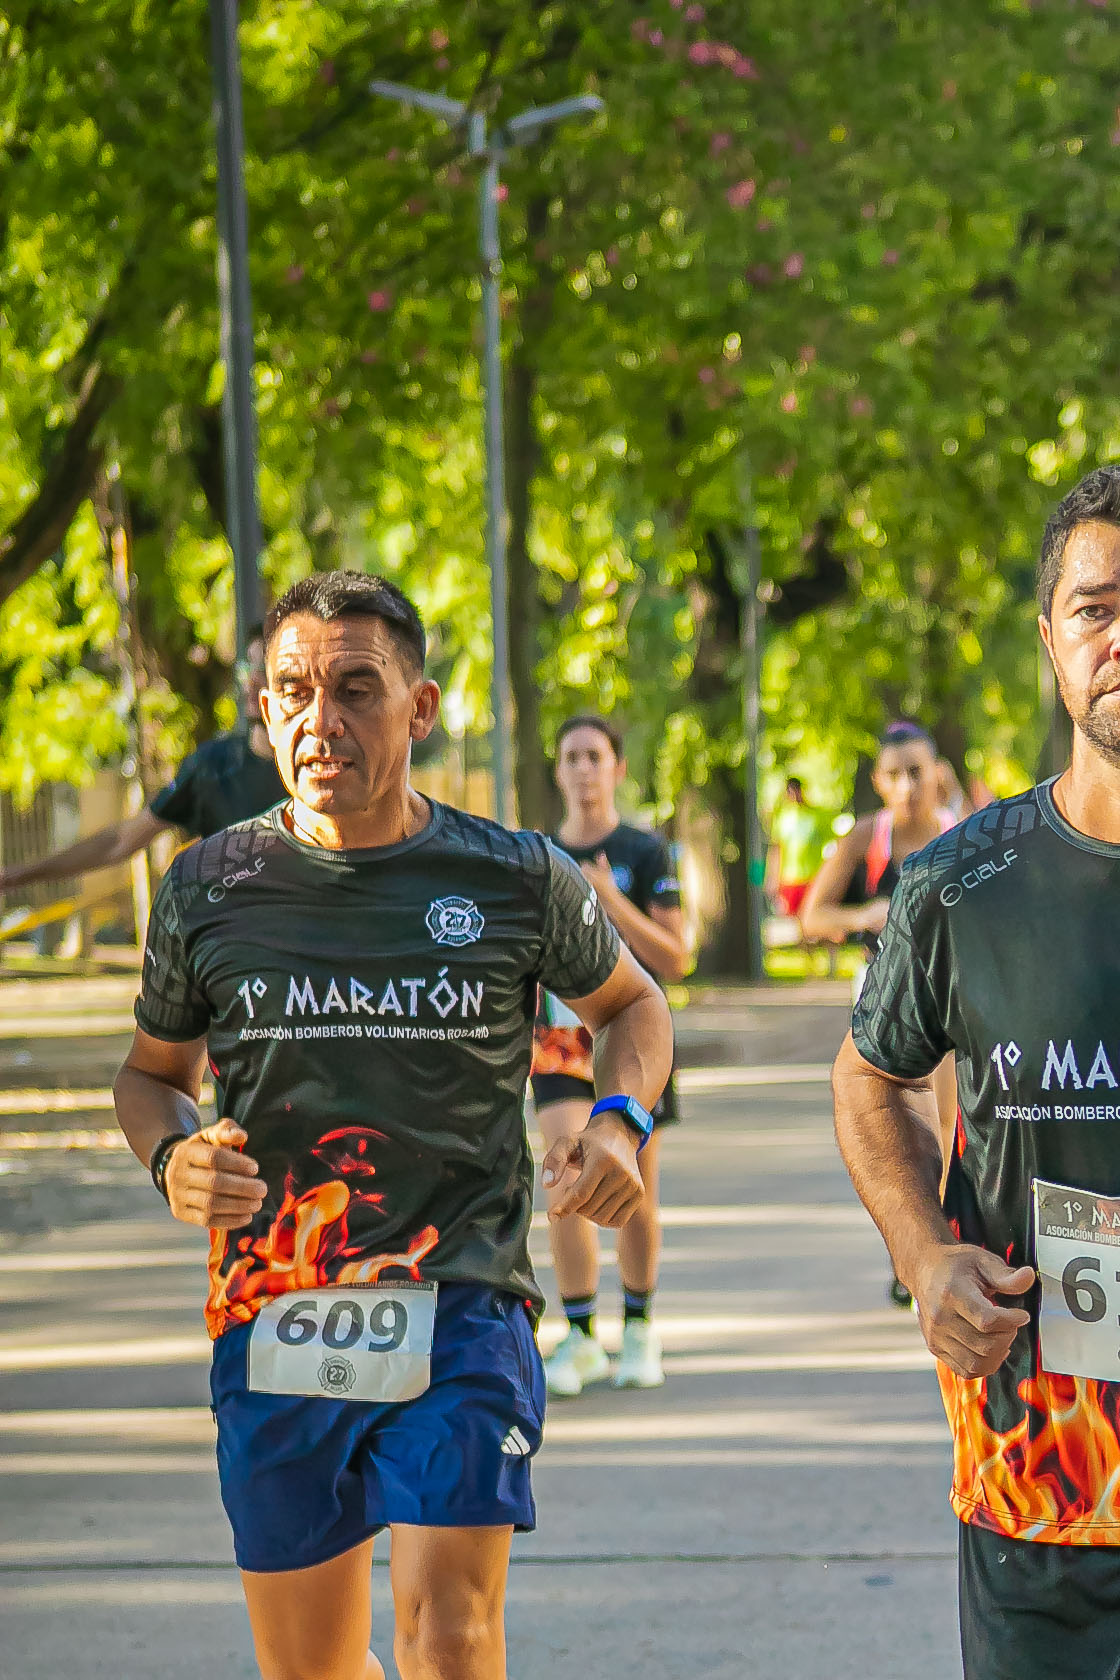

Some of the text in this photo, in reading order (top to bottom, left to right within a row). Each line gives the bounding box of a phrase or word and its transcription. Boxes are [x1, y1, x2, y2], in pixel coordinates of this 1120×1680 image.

[445, 911, 467, 929] 27
[285, 965, 483, 1018] MARATÓN
[295, 1024, 363, 1040] BOMBEROS
[365, 1025, 446, 1041] VOLUNTARIOS
[1046, 1224, 1093, 1241] ASOCIACIÓN
[276, 1300, 408, 1352] 609
[330, 1366, 346, 1381] 27
